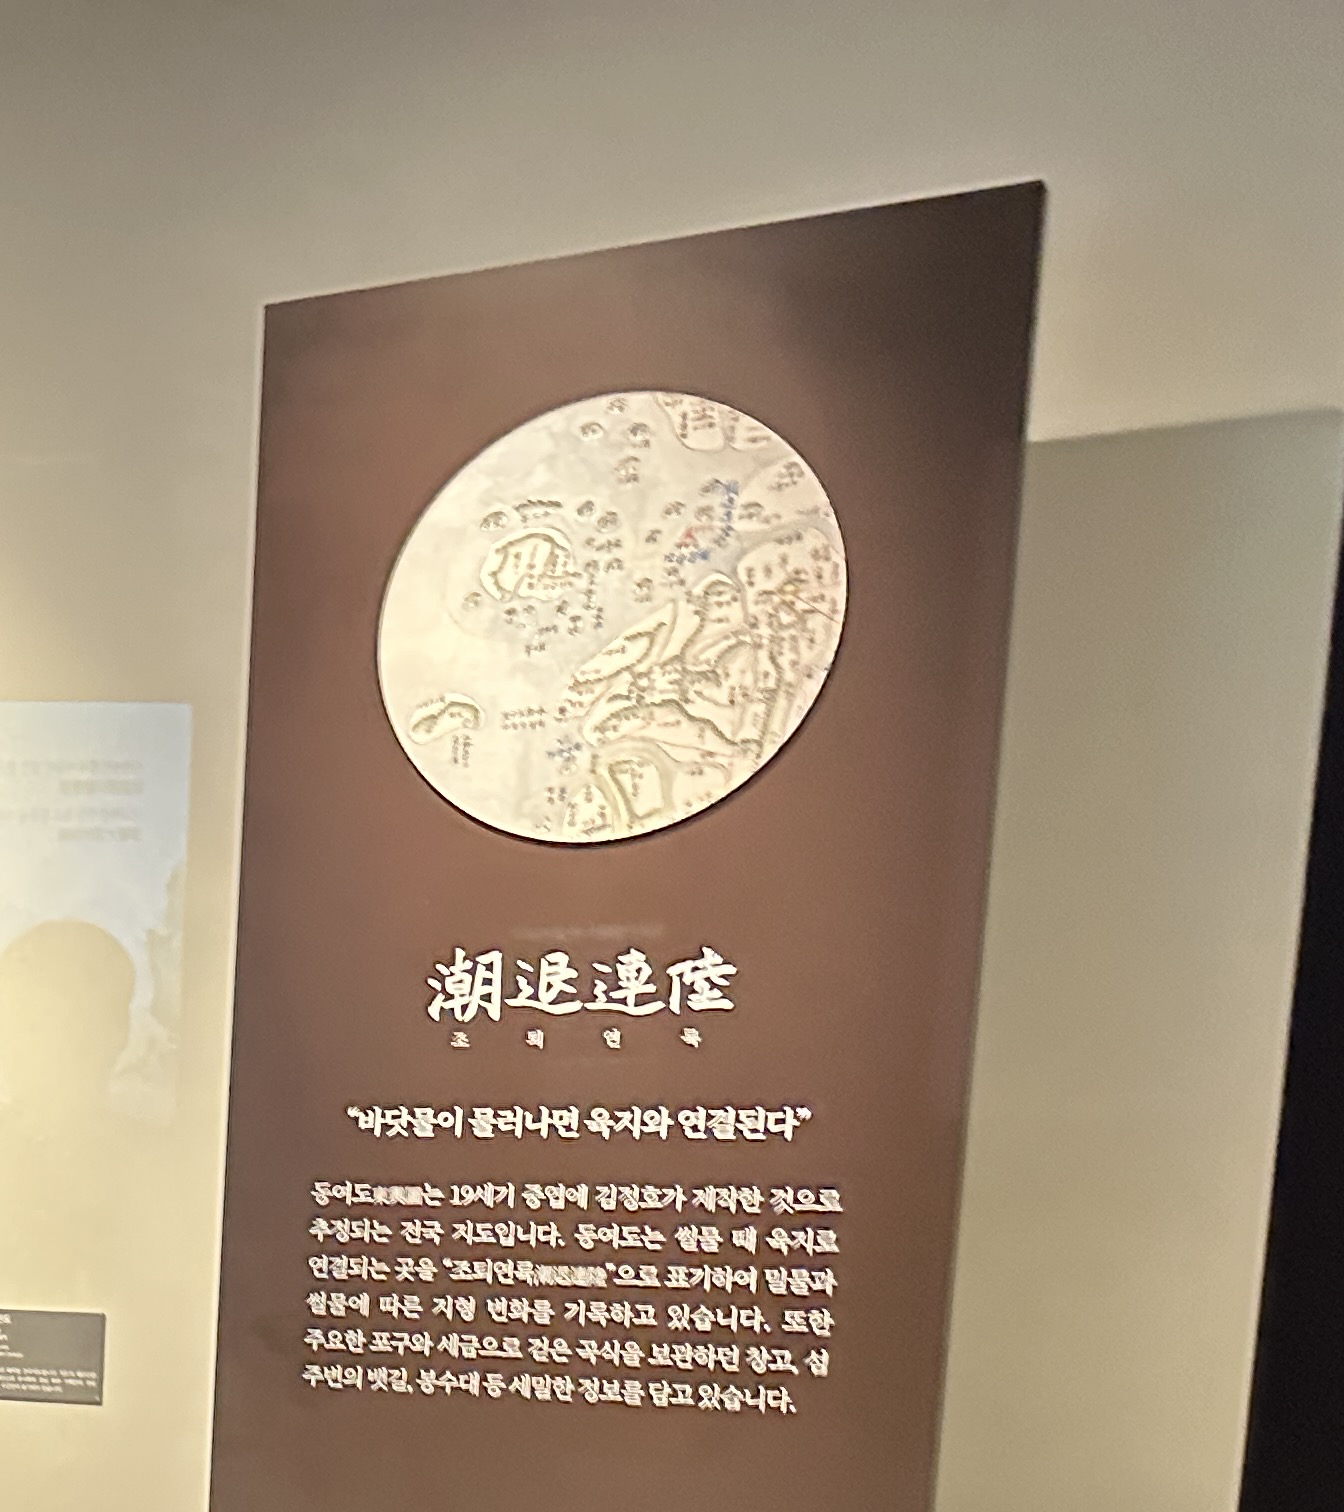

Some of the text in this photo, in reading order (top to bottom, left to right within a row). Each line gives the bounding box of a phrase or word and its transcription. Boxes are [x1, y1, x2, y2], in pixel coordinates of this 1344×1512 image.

[425, 945, 738, 1022] 潮退連陸
[346, 1105, 812, 1142] “바닷물이 물러나면 육지와 연결된다”
[449, 1182, 516, 1209] 19세기
[521, 1183, 589, 1211] 중엽에
[595, 1184, 688, 1213] 김정호가
[691, 1185, 764, 1214] 제작한
[769, 1186, 844, 1215] 것으로
[308, 1217, 840, 1257] 추정되는 전국 지도입니다. 동여도는 썰물 때 육지로
[308, 1254, 392, 1281] 연결되는
[394, 1256, 439, 1282] 곳을
[664, 1264, 758, 1294] 표기하여
[762, 1266, 839, 1298] 밀물과
[305, 1291, 835, 1337] 썰물에 따른 지형 변화를 기록하고 있습니다. 또한
[303, 1328, 367, 1354] 주요한
[368, 1331, 434, 1358] 포구와
[437, 1332, 524, 1360] 세금으로
[575, 1339, 646, 1368] 곡식을
[648, 1342, 740, 1373] 보관하던
[745, 1345, 799, 1376] 창고,
[804, 1348, 830, 1378] 섬
[302, 1364, 798, 1414] 주변의 뱃길, 봉수대 등 세밀한 정보를 담고 있습니다.
